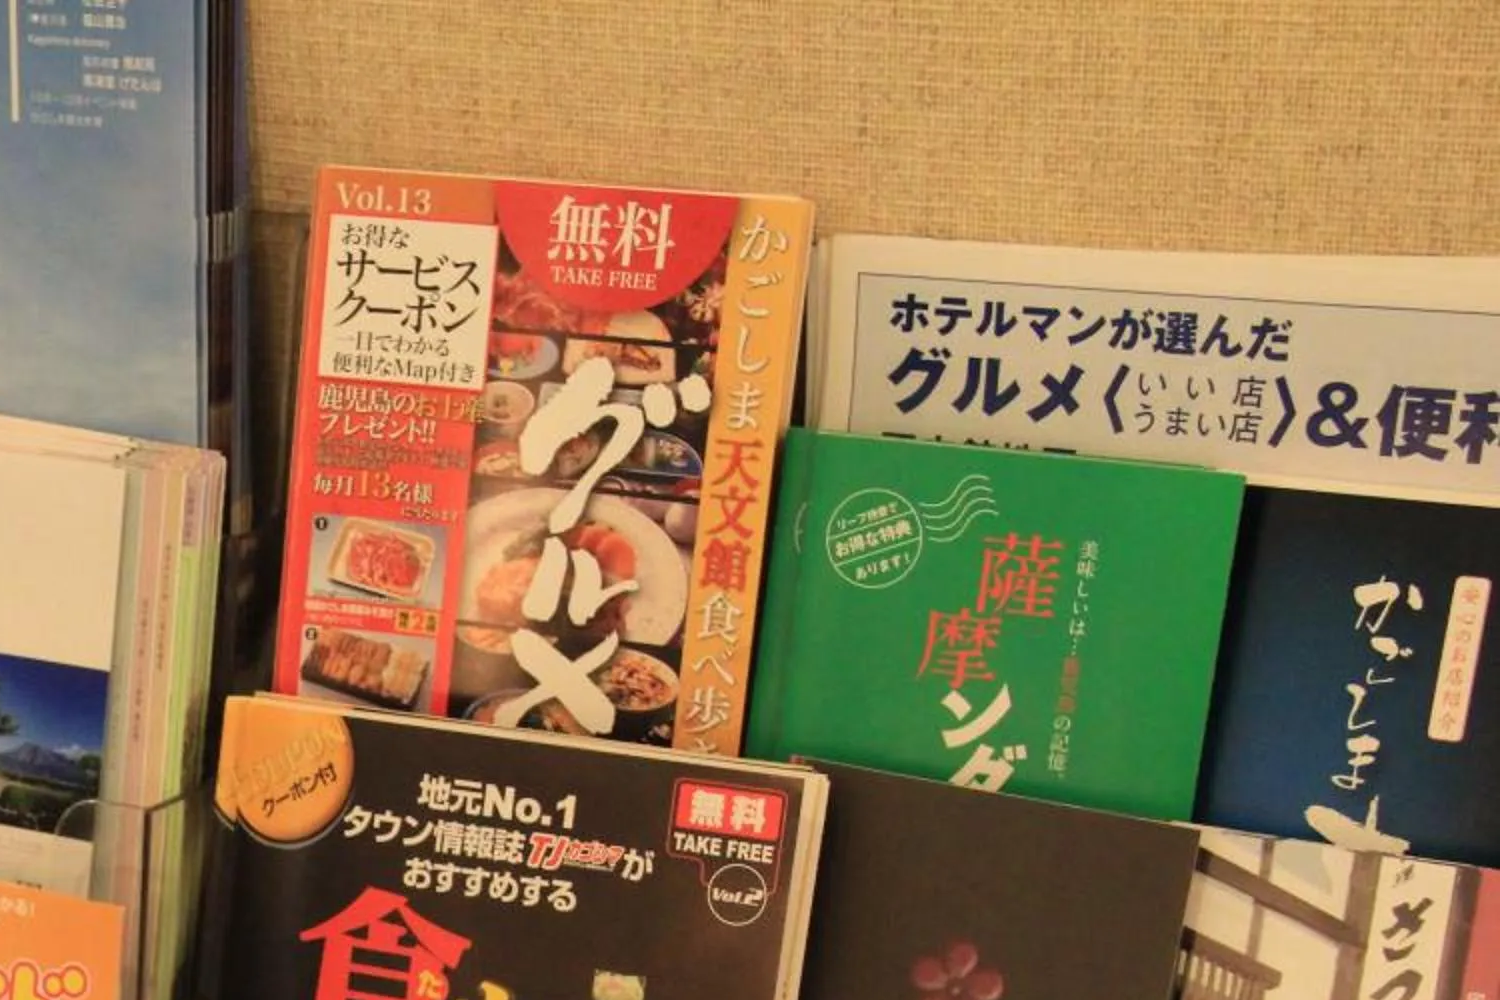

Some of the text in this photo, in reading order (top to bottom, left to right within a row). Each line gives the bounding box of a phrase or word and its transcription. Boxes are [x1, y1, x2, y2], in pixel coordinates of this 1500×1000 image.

[336, 182, 431, 215] Vol.13
[341, 223, 410, 249] お得な
[547, 195, 675, 270] 無料
[336, 250, 481, 296] サービス
[550, 267, 658, 292] TAKE FREE
[335, 291, 479, 334] クーポン
[888, 293, 1293, 363] ホテルマンが選んだ
[337, 332, 450, 357] 一目でわかる
[332, 352, 476, 385] 便利なMap付き
[262, 761, 337, 818] クーポン付
[418, 774, 576, 829] 地元No.1
[690, 790, 767, 833] 無料
[673, 832, 774, 863] TAKE FREE
[402, 857, 578, 913] おすすめする
[712, 887, 764, 907] Vol.2
